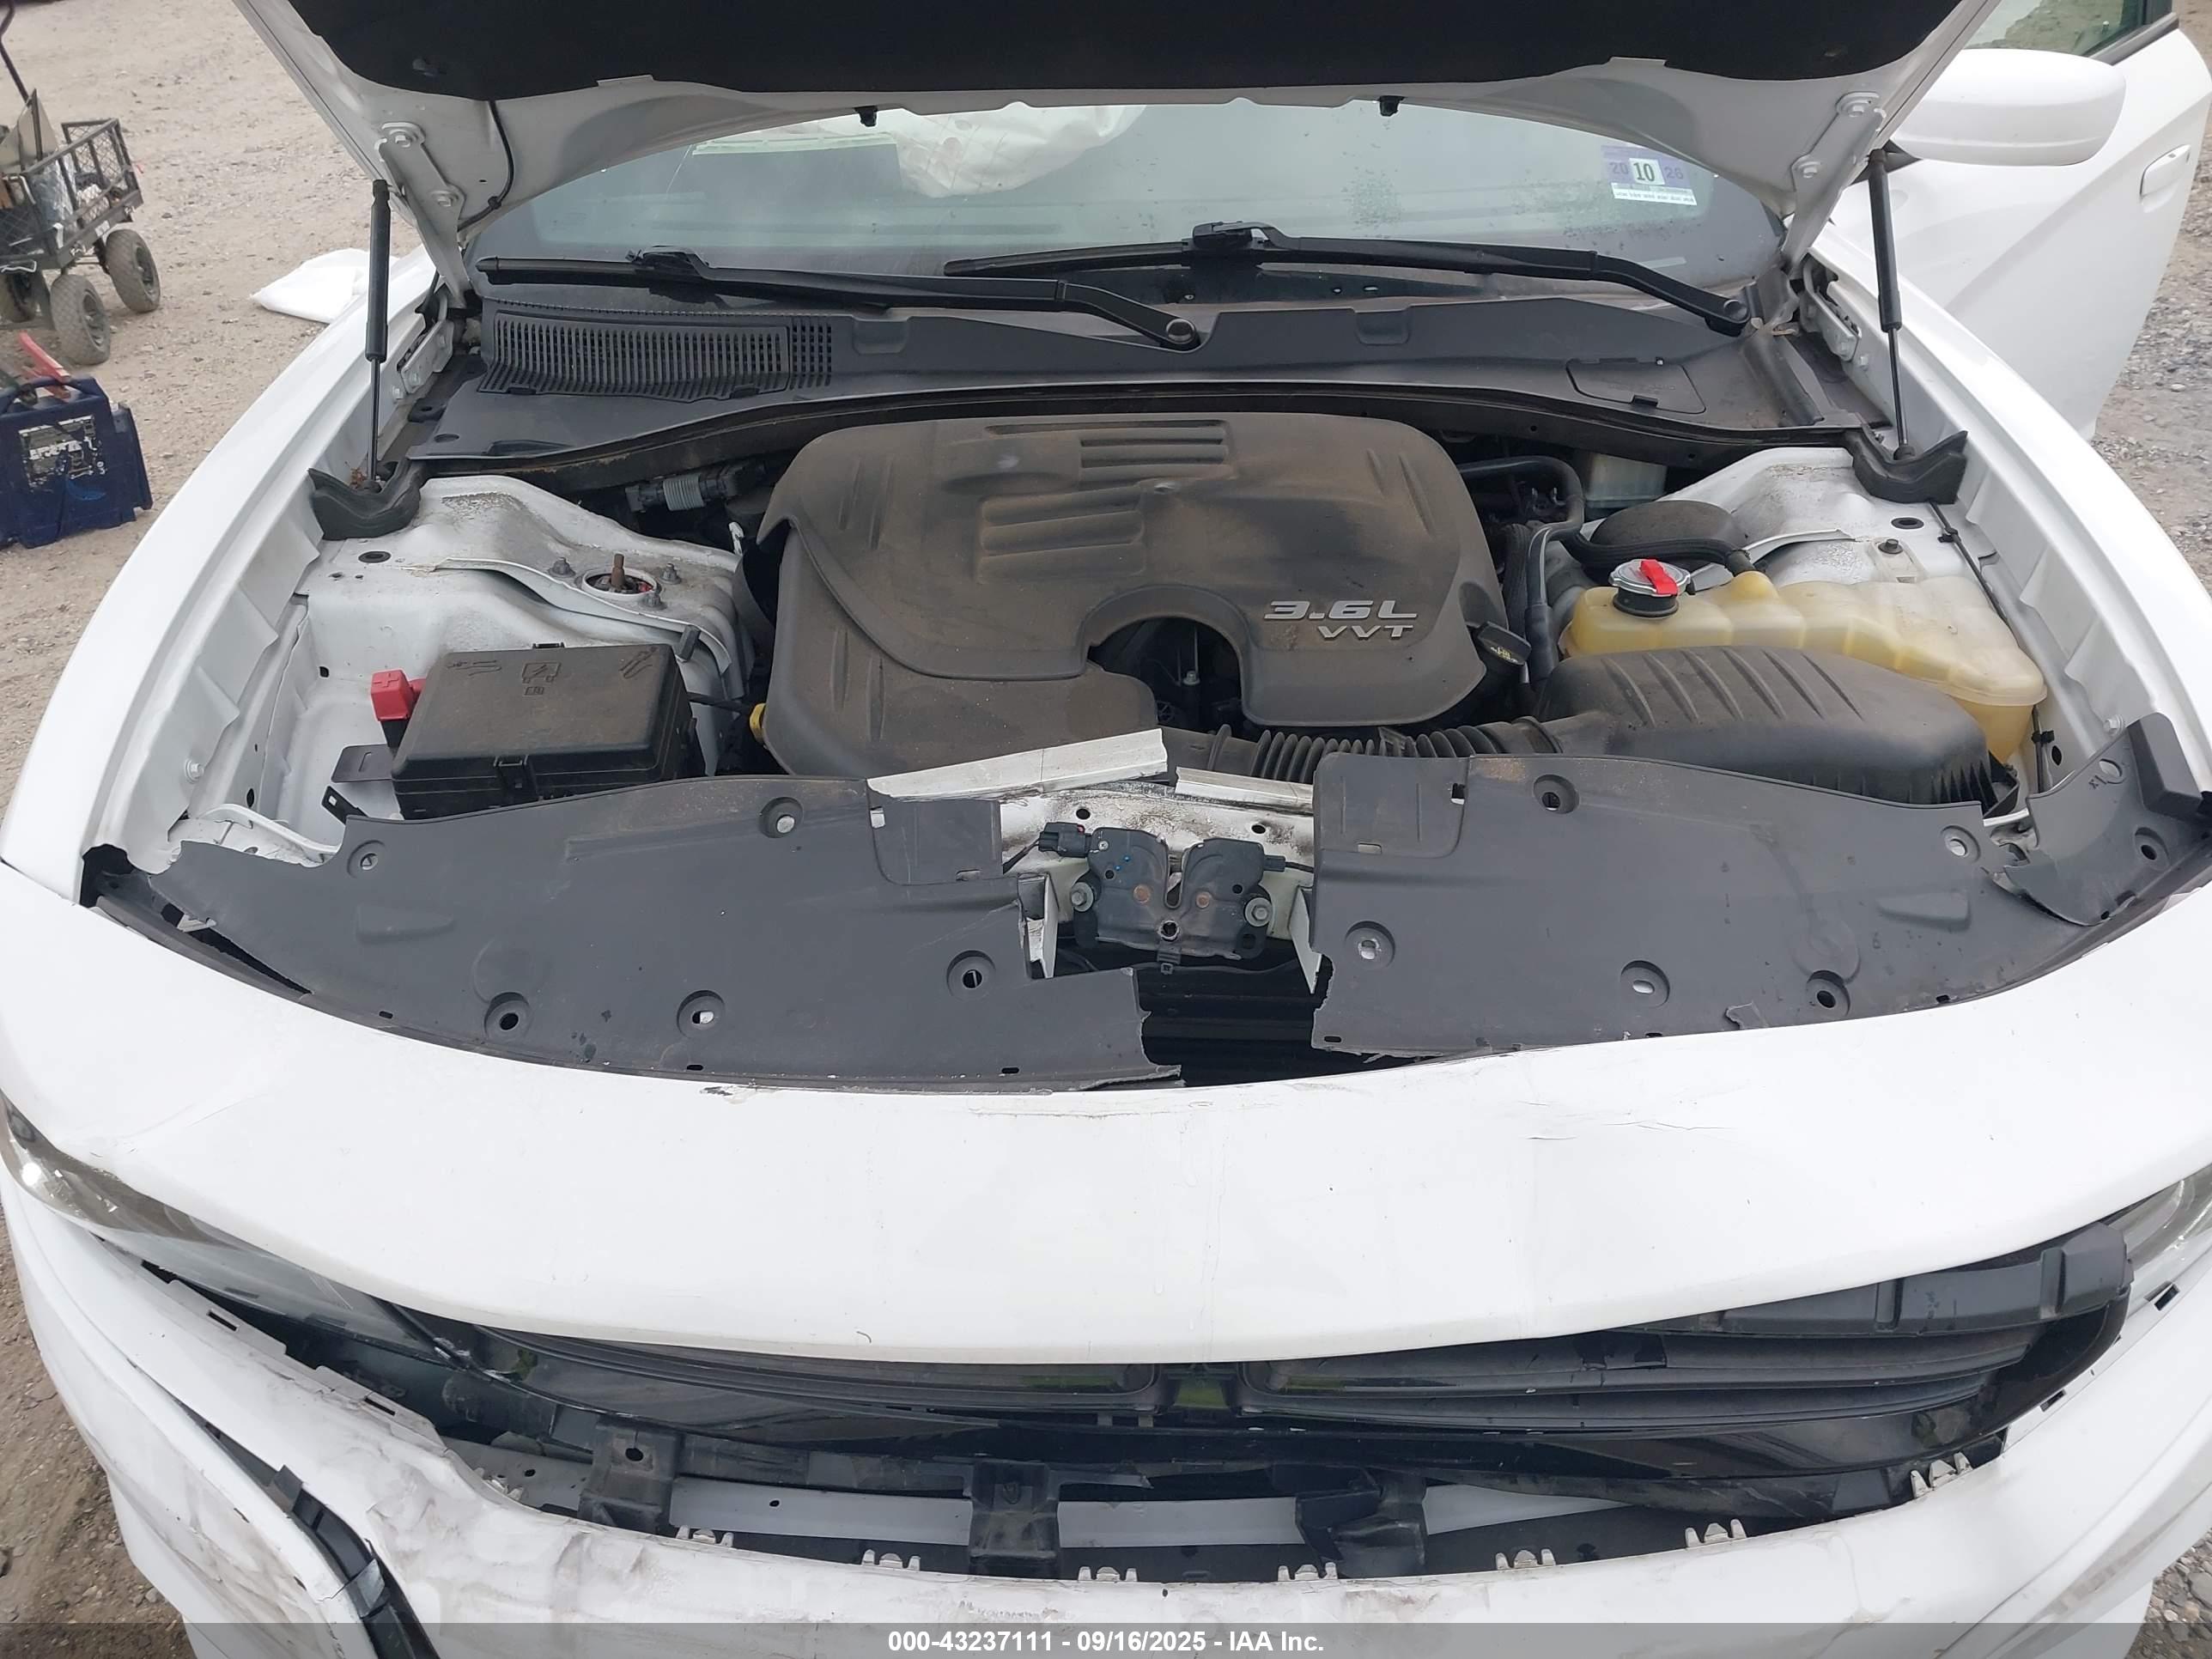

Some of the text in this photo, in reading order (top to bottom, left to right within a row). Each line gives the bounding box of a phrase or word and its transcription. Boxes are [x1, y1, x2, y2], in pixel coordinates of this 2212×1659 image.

[1633, 162, 1656, 182] 10
[1264, 599, 1418, 620] 3.6L
[1316, 624, 1414, 640] VVT
